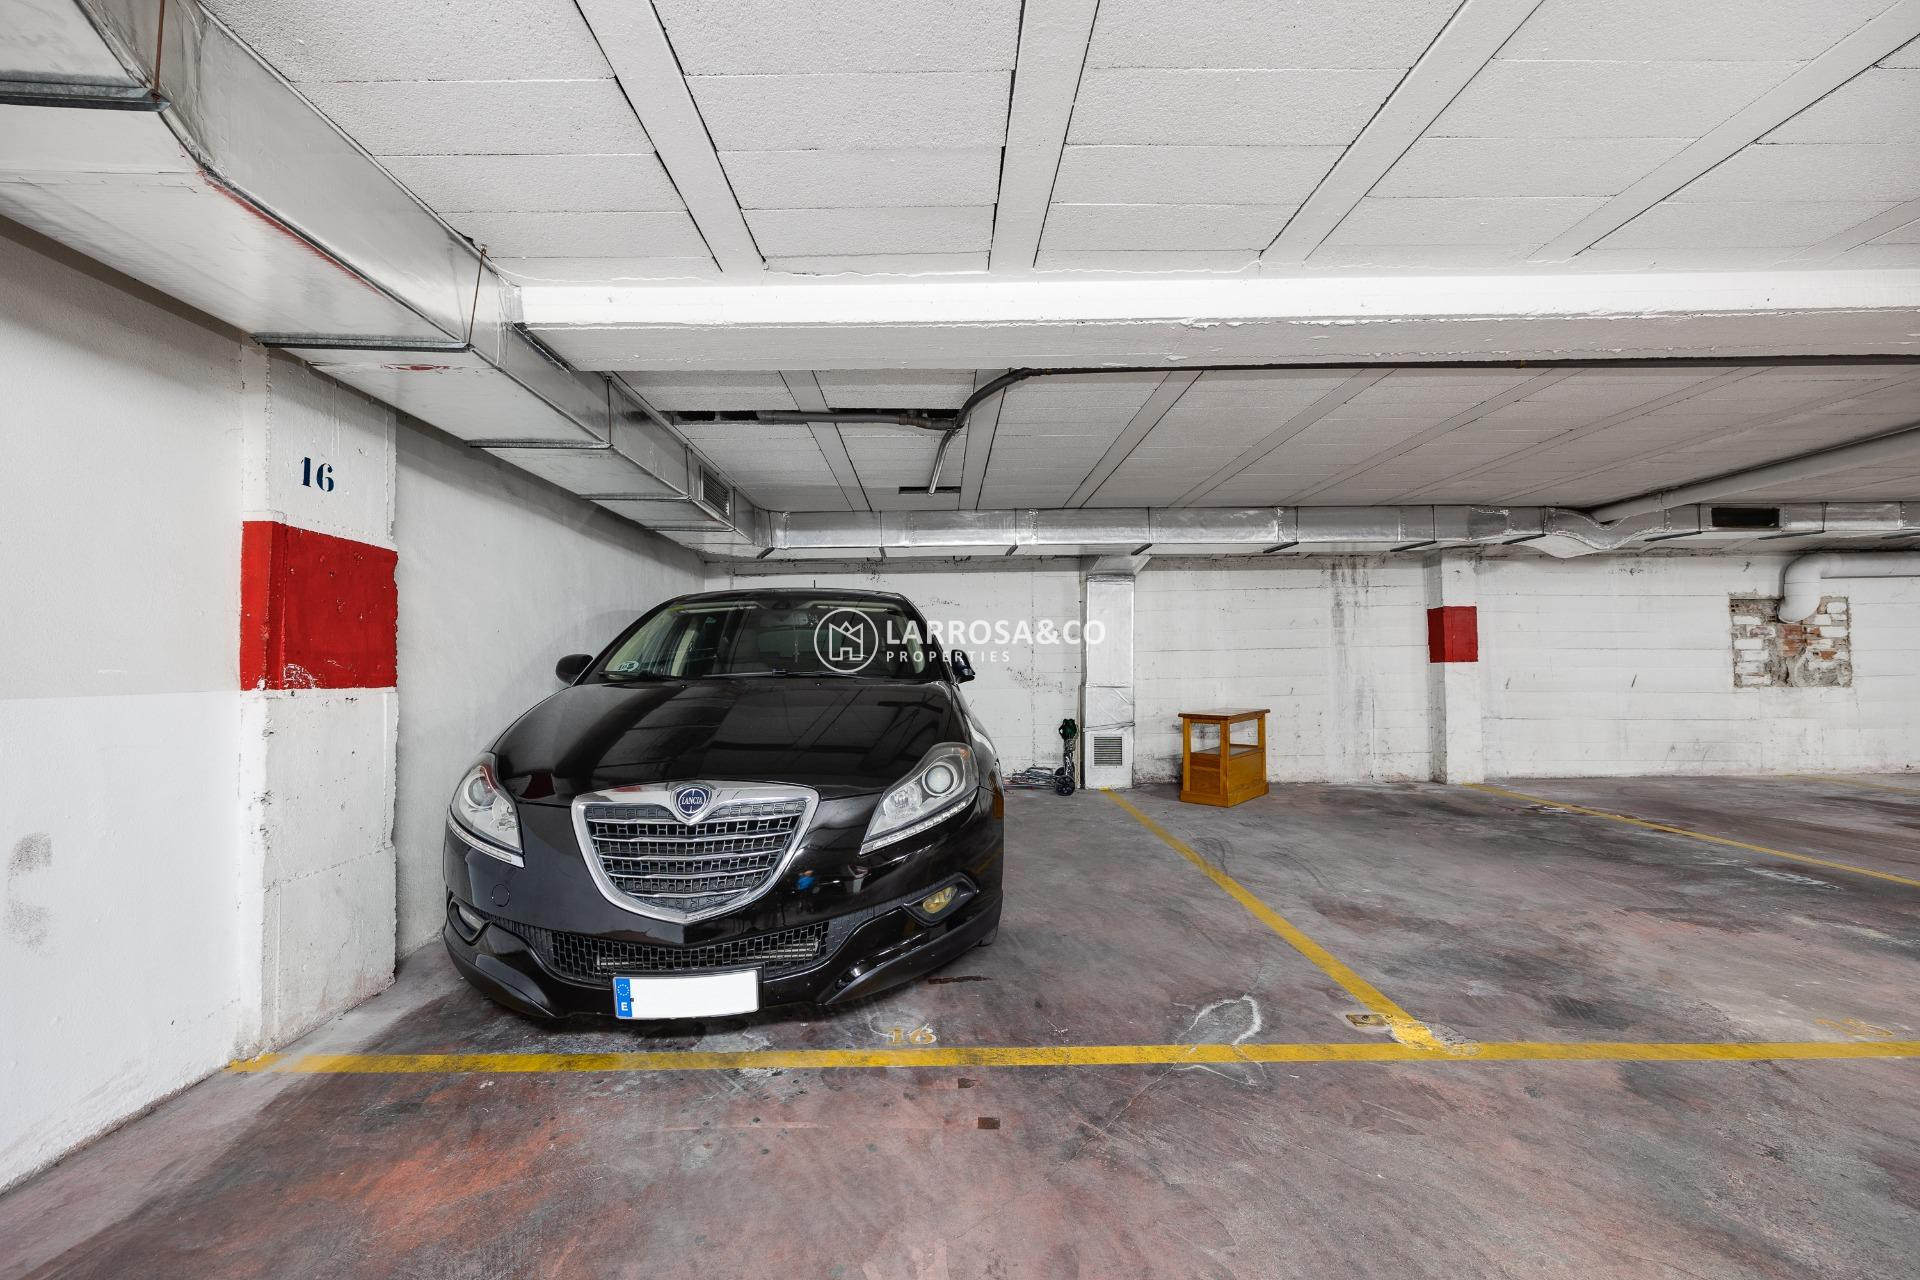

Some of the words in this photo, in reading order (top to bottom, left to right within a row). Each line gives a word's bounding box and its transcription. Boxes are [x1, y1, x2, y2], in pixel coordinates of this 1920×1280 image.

[301, 456, 335, 493] 16
[681, 796, 703, 805] LANCIA
[621, 1002, 629, 1011] E
[888, 1025, 937, 1045] 16
